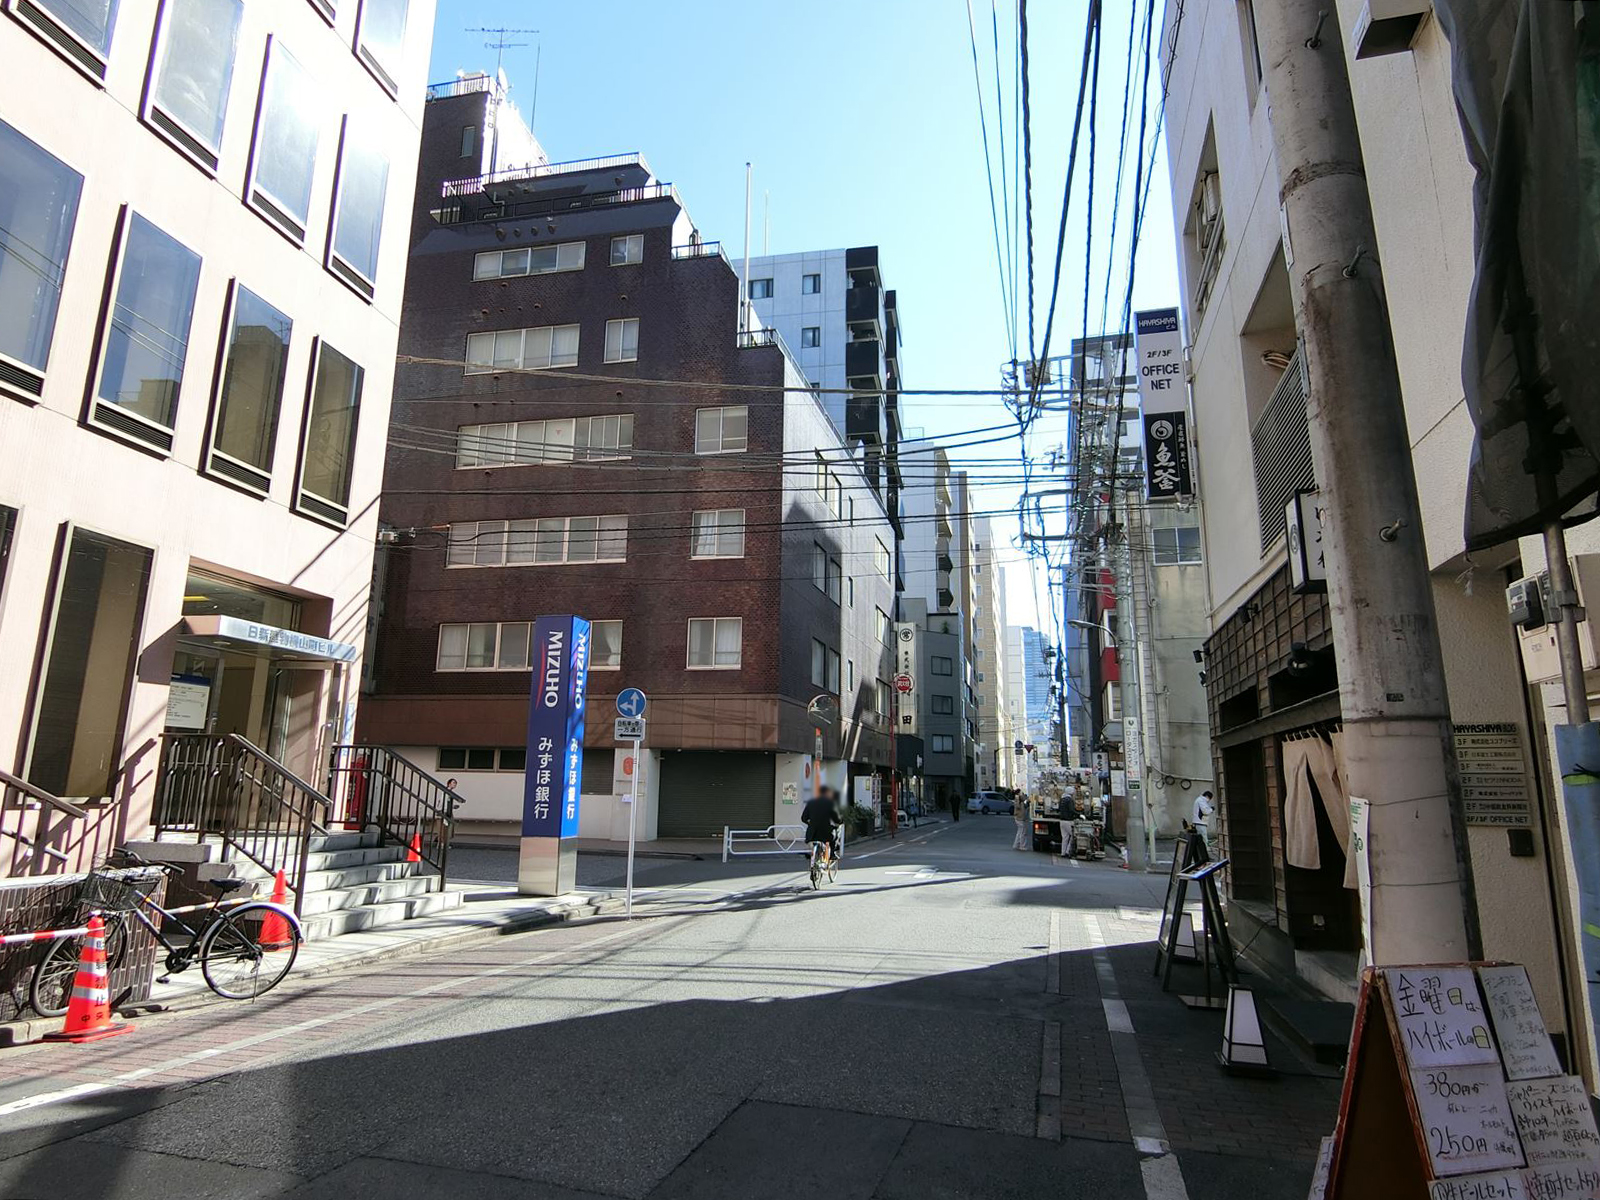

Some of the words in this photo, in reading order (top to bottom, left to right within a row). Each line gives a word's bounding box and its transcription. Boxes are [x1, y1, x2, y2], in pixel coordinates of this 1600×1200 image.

[1138, 317, 1176, 328] HAYASHIYA
[1146, 349, 1173, 359] 2F/3F
[1141, 363, 1180, 377] OFFICE
[1150, 379, 1172, 391] NET
[544, 630, 564, 709] MIZUHO
[575, 634, 587, 709] MIZUHO
[1453, 724, 1502, 733] HAYASHIYA
[534, 737, 553, 820] みずほ銀行
[566, 738, 579, 820] みずほ銀行
[1463, 789, 1474, 797] 2F
[1490, 815, 1513, 823] OFFICE
[1430, 1125, 1488, 1158] 250円
